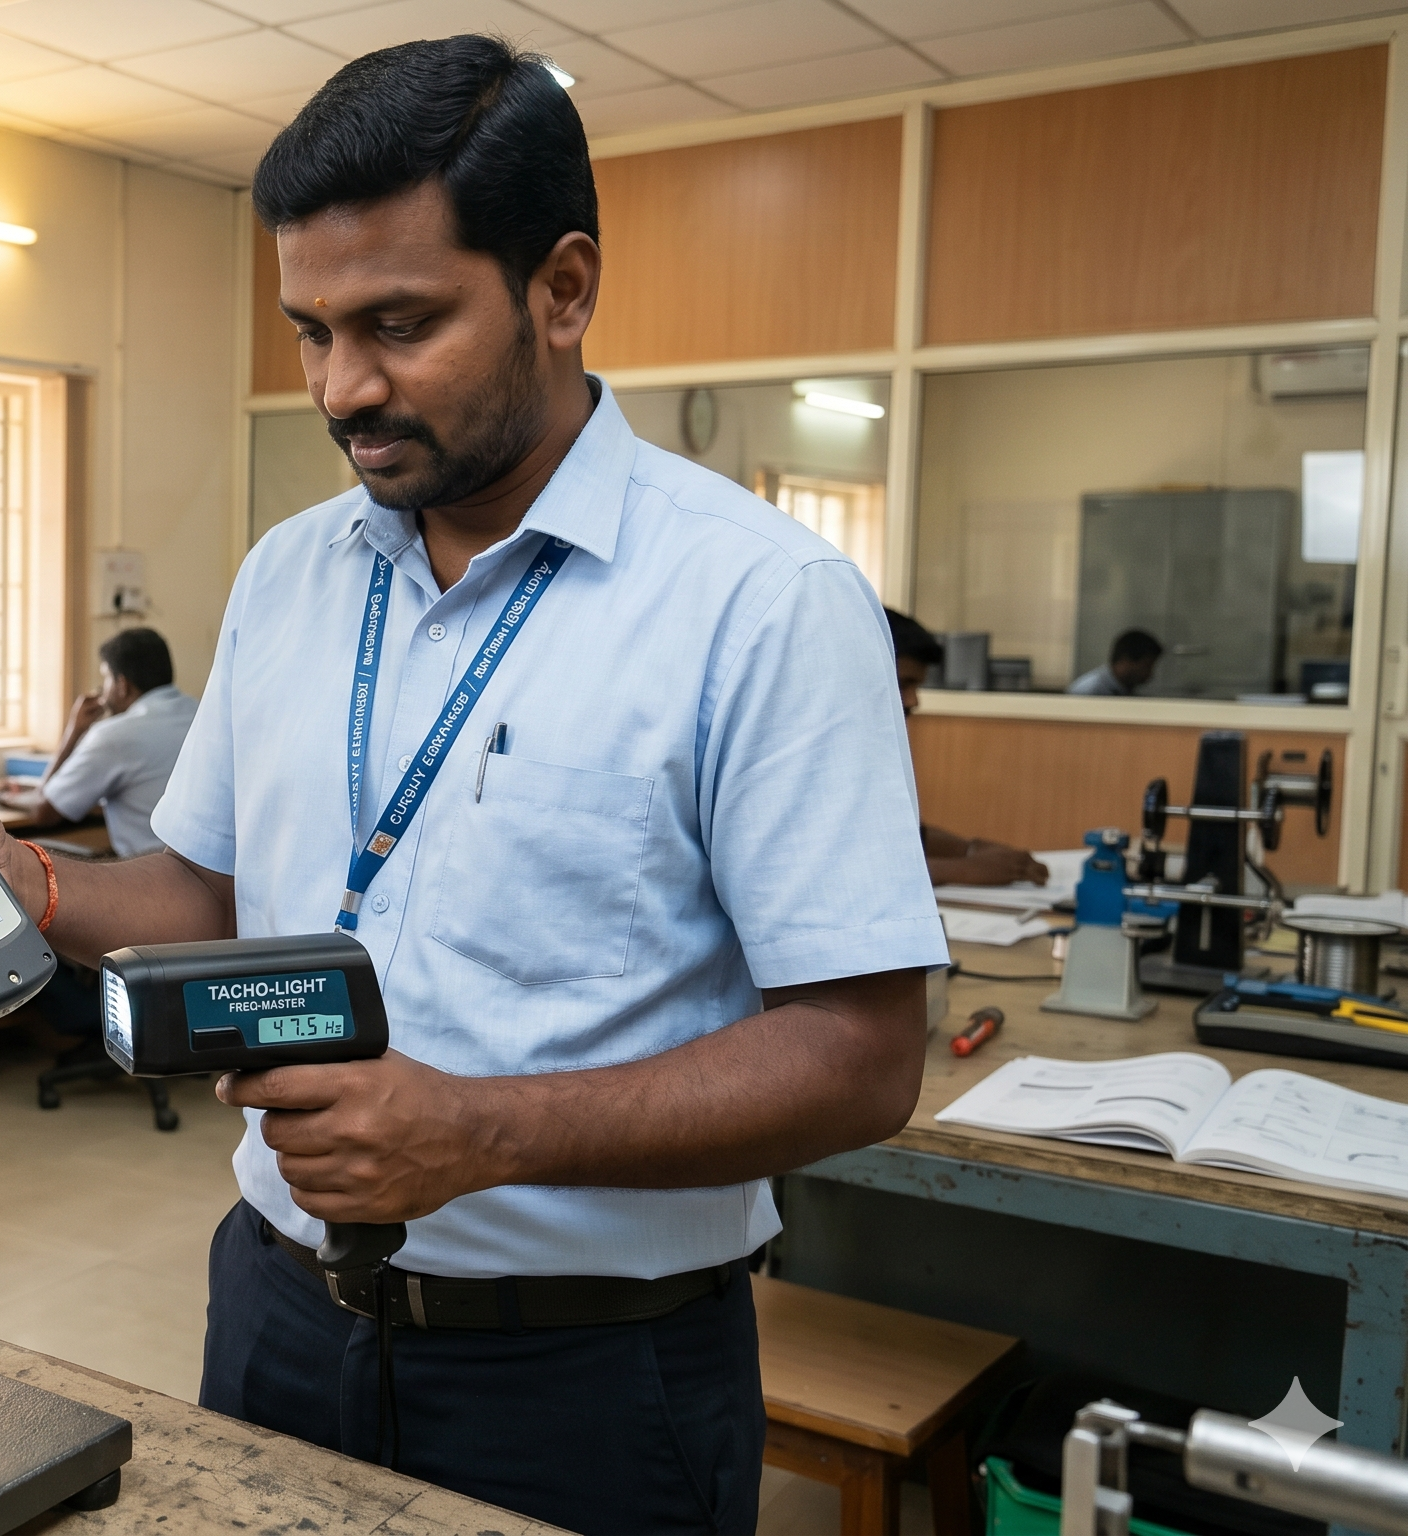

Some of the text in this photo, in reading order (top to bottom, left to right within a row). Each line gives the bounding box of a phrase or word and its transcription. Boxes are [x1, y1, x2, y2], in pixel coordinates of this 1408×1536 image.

[208, 978, 326, 1000] TACHO-LIGHT
[229, 998, 305, 1012] FREQ-MASTER
[274, 1017, 317, 1037] 47.5
